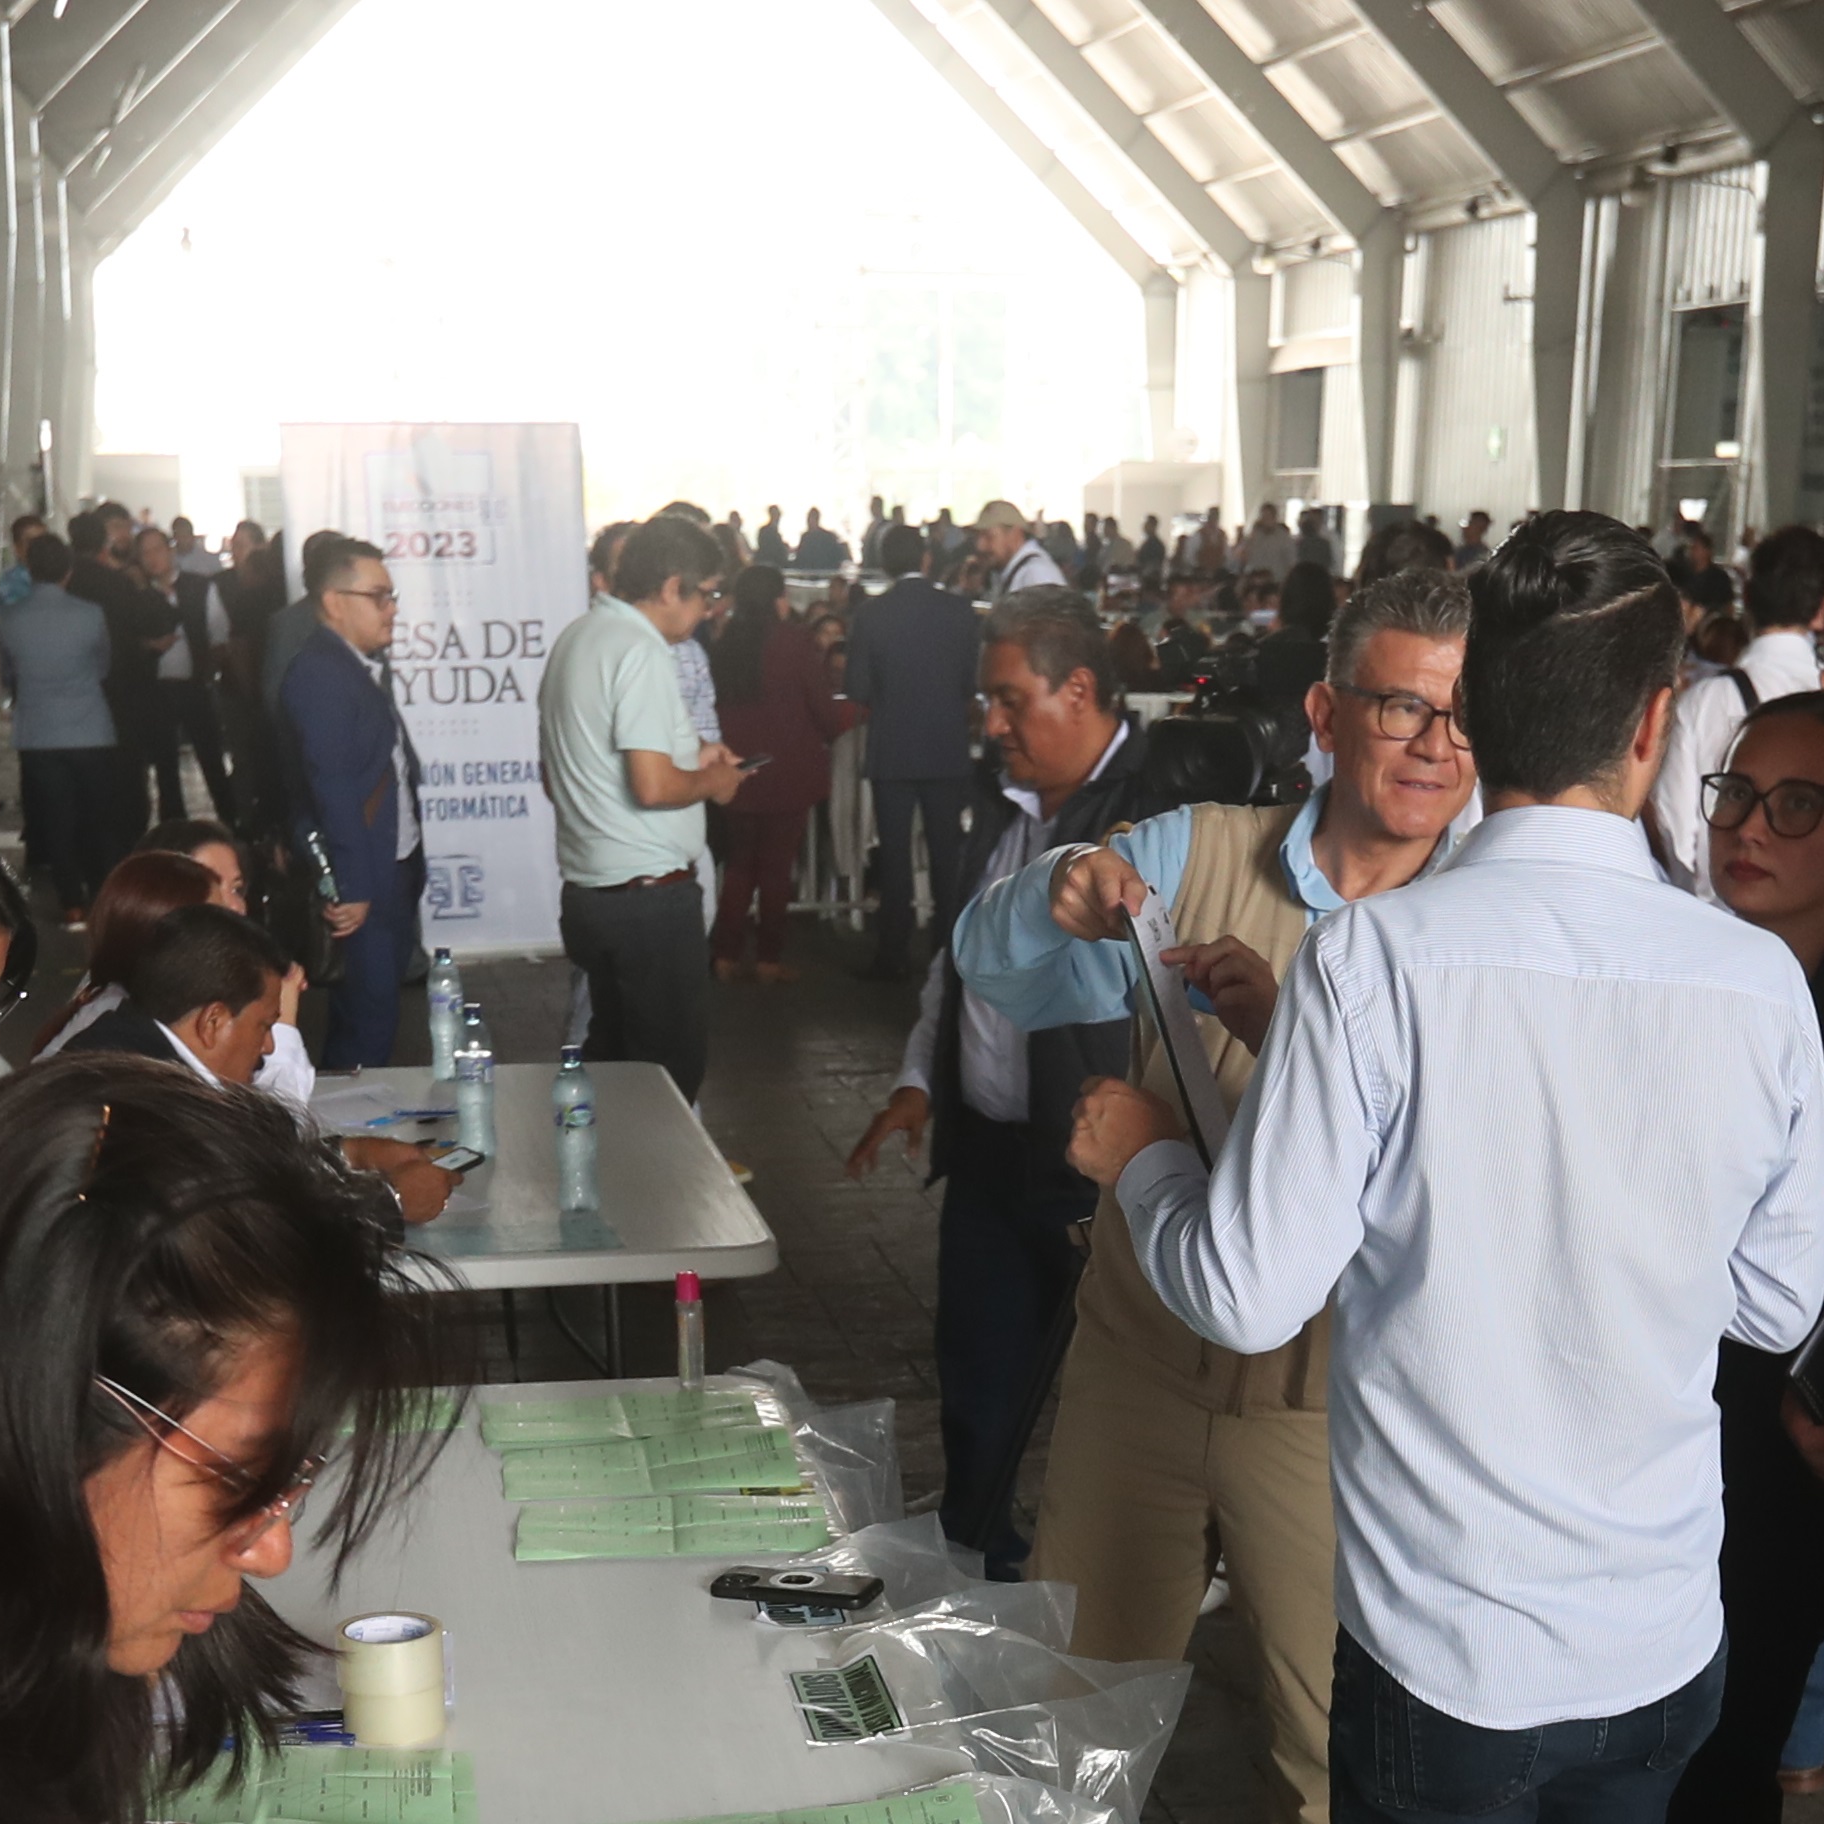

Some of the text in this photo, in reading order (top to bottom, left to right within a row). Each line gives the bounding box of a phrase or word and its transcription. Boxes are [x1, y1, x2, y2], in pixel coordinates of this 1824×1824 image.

[385, 530, 479, 560] 2023
[389, 619, 546, 661] ESA DE
[390, 666, 525, 706] YUDA
[420, 760, 455, 787] IÓN
[423, 792, 529, 822] FORMÁTICA
[798, 1673, 864, 1739] DIPUTADOS
